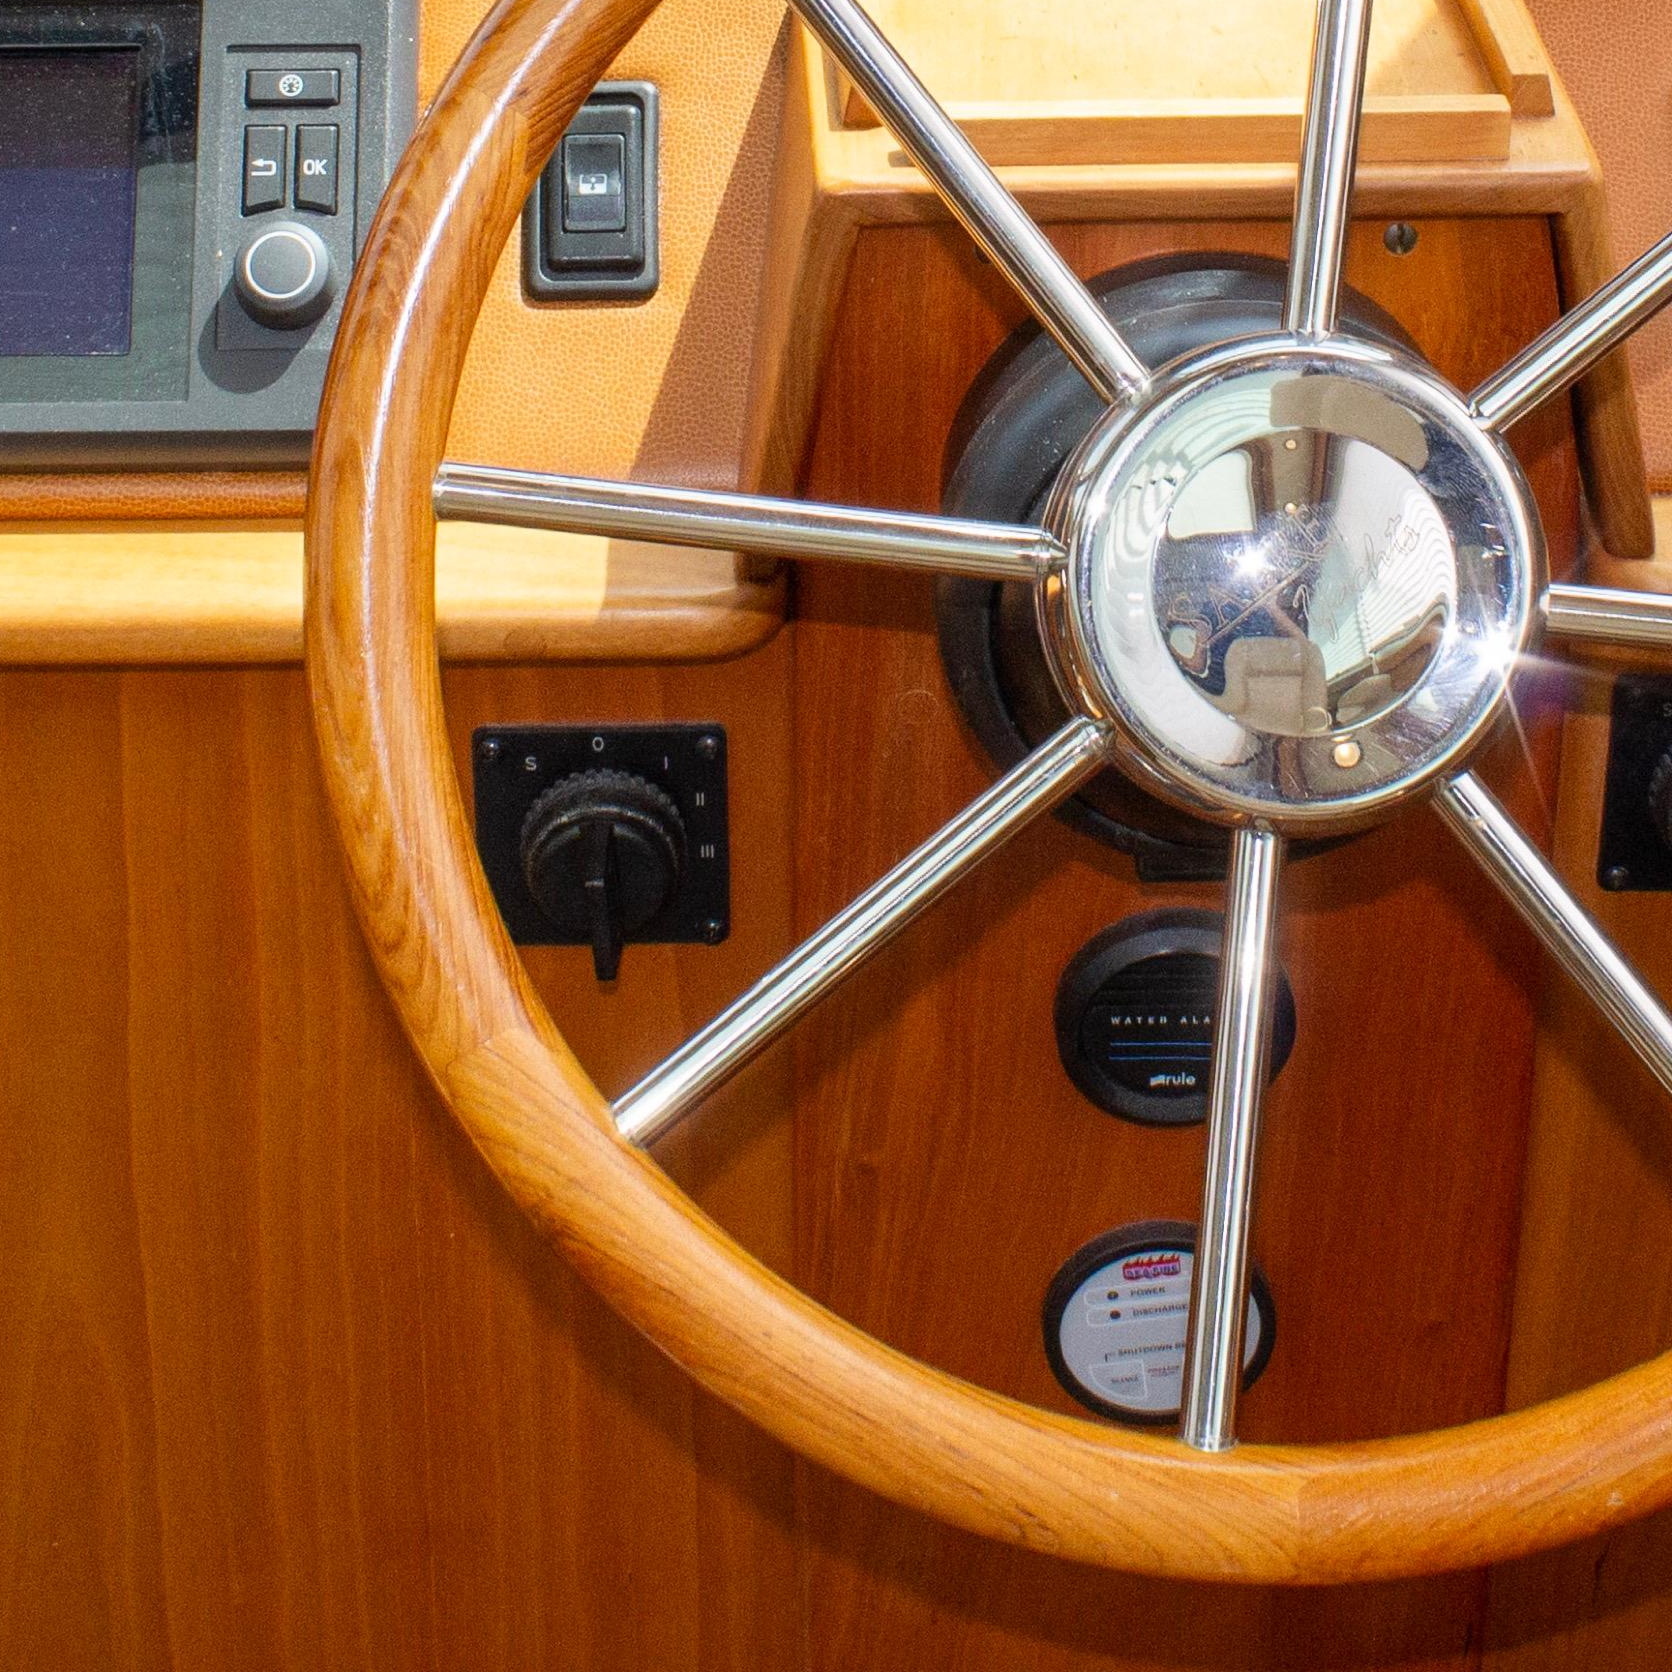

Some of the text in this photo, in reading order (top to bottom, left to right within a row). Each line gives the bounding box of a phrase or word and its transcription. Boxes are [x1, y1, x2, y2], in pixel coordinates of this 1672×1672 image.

[303, 159, 329, 176] OK
[524, 756, 538, 771] S
[1111, 1016, 1167, 1025] WATER
[1166, 1071, 1196, 1085] rule
[1130, 1286, 1166, 1296] POWER
